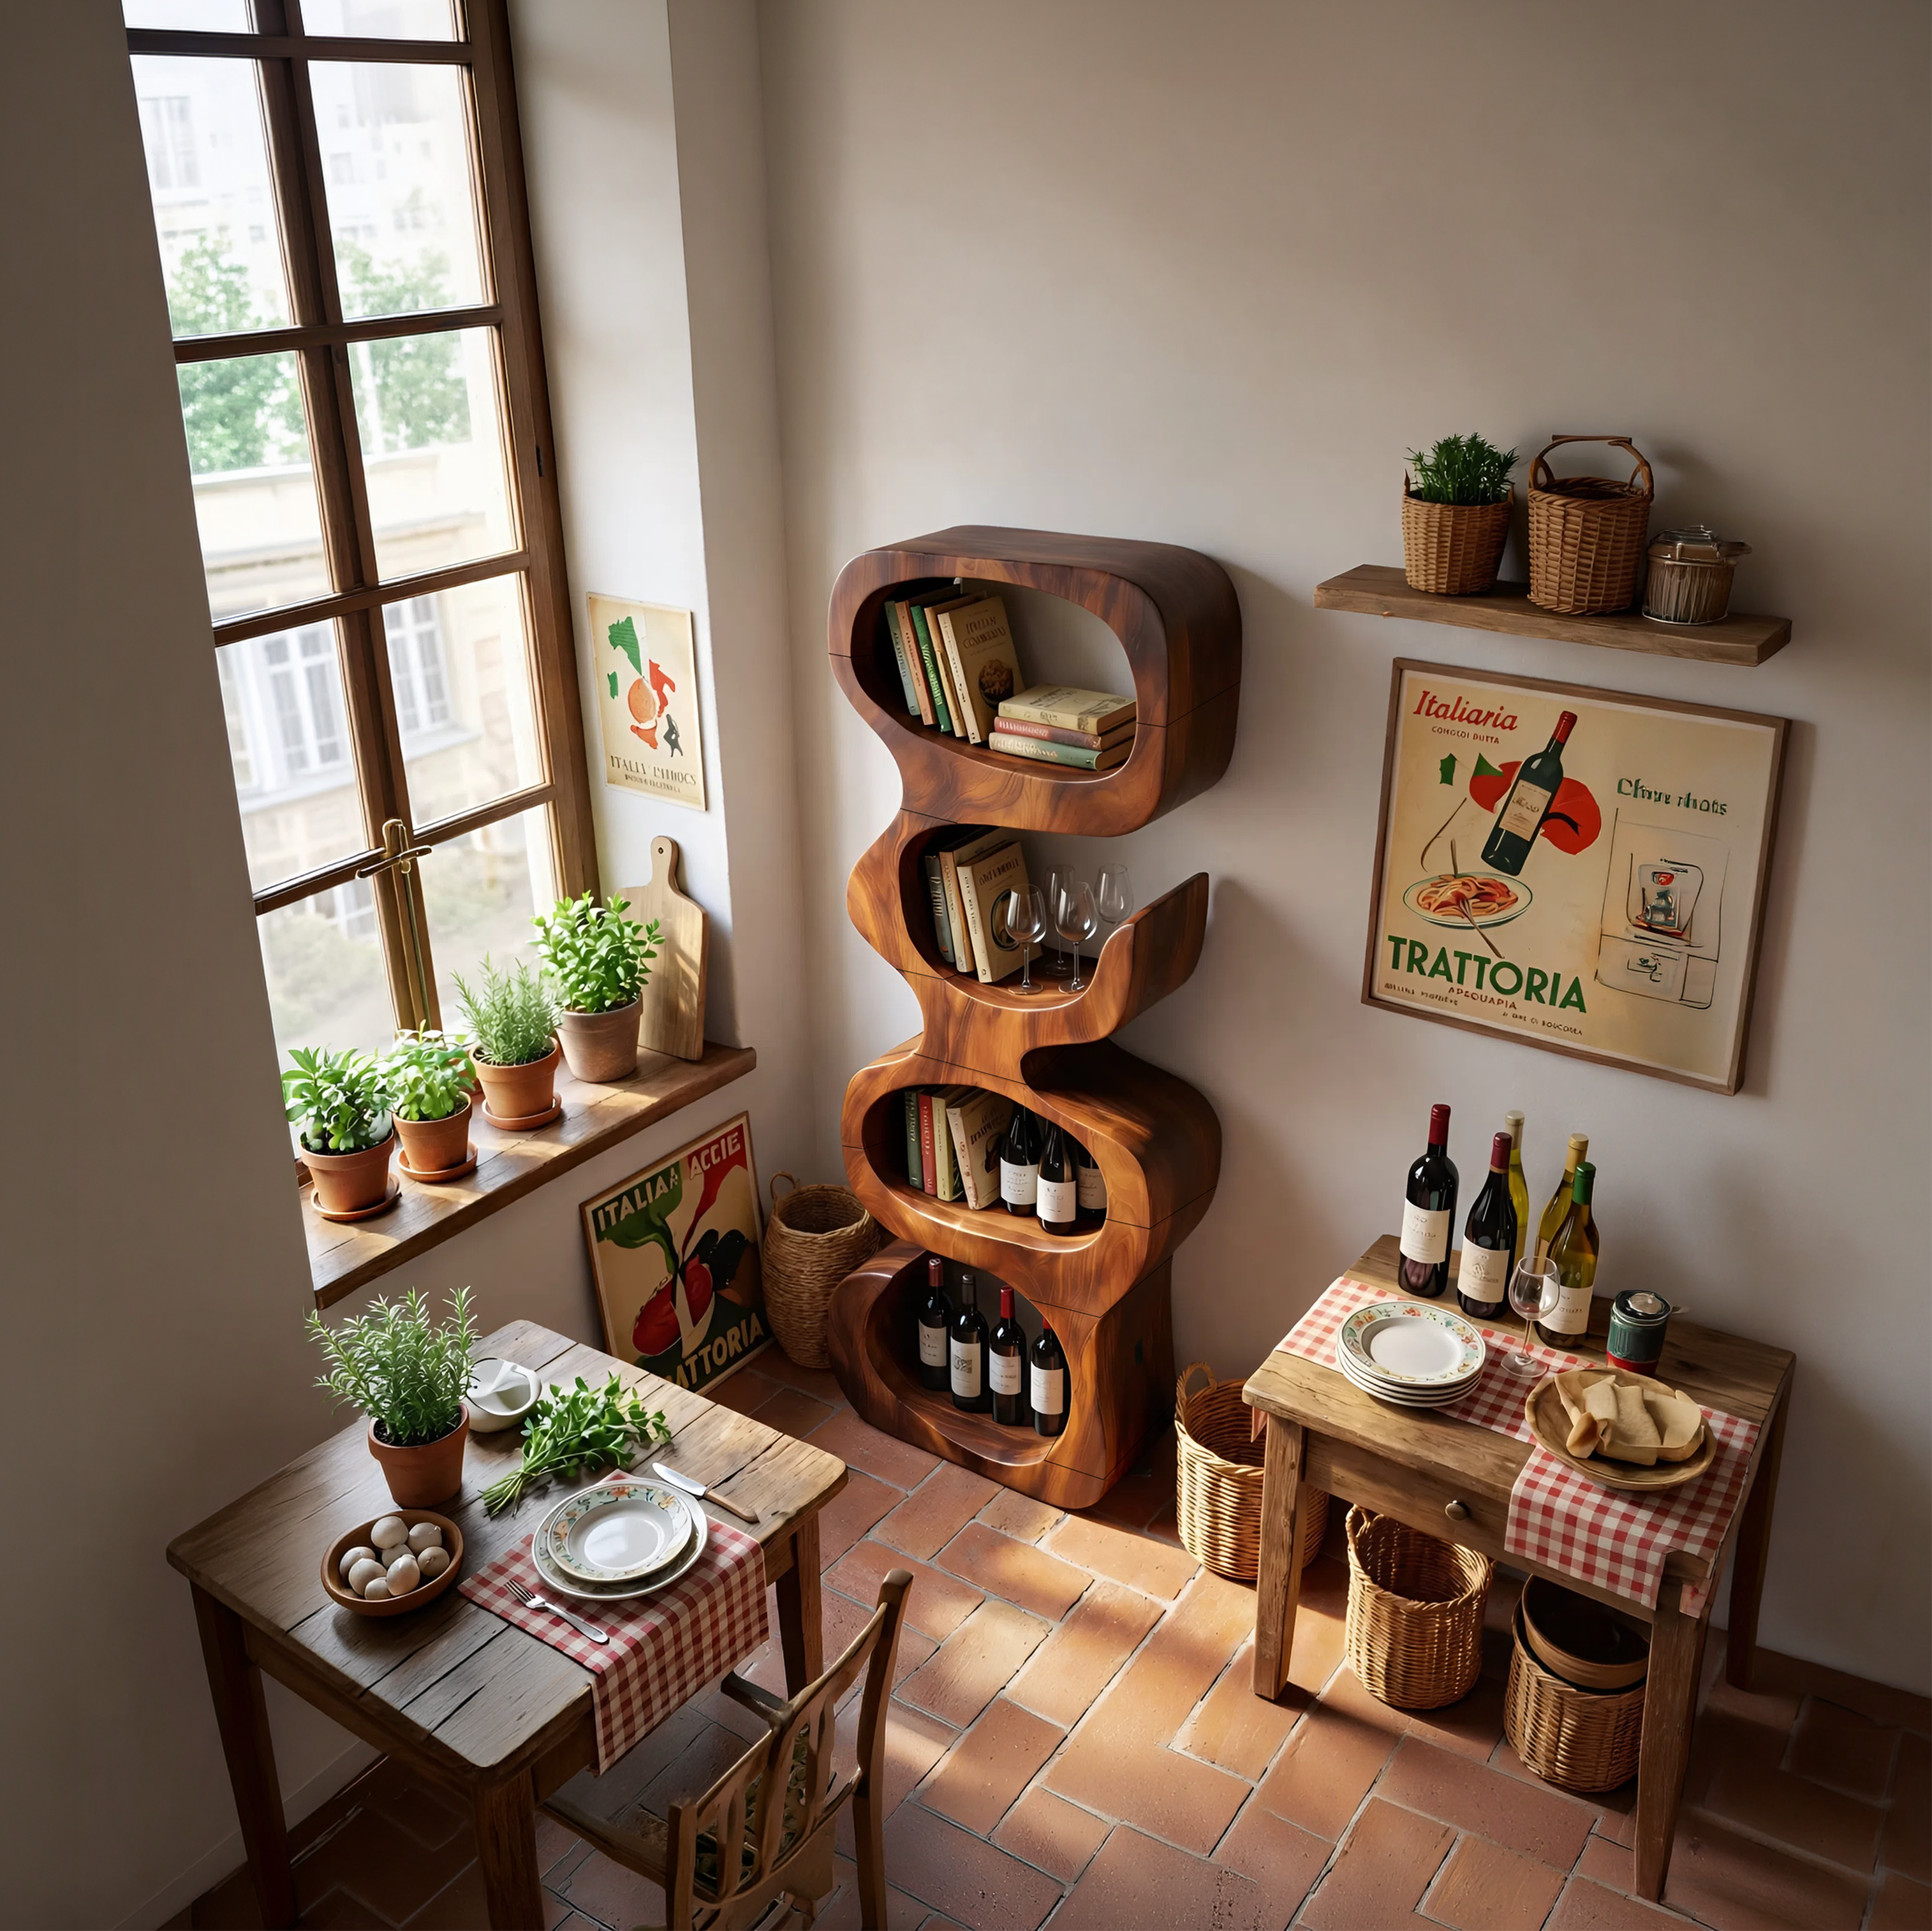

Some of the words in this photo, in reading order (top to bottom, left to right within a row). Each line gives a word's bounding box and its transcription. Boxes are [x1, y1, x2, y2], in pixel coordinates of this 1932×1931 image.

[1413, 690, 1518, 731] Italiaria
[1388, 935, 1587, 1013] TRATTORIA
[689, 1131, 741, 1180] ACCIE
[665, 1312, 764, 1389] ATTORIA
